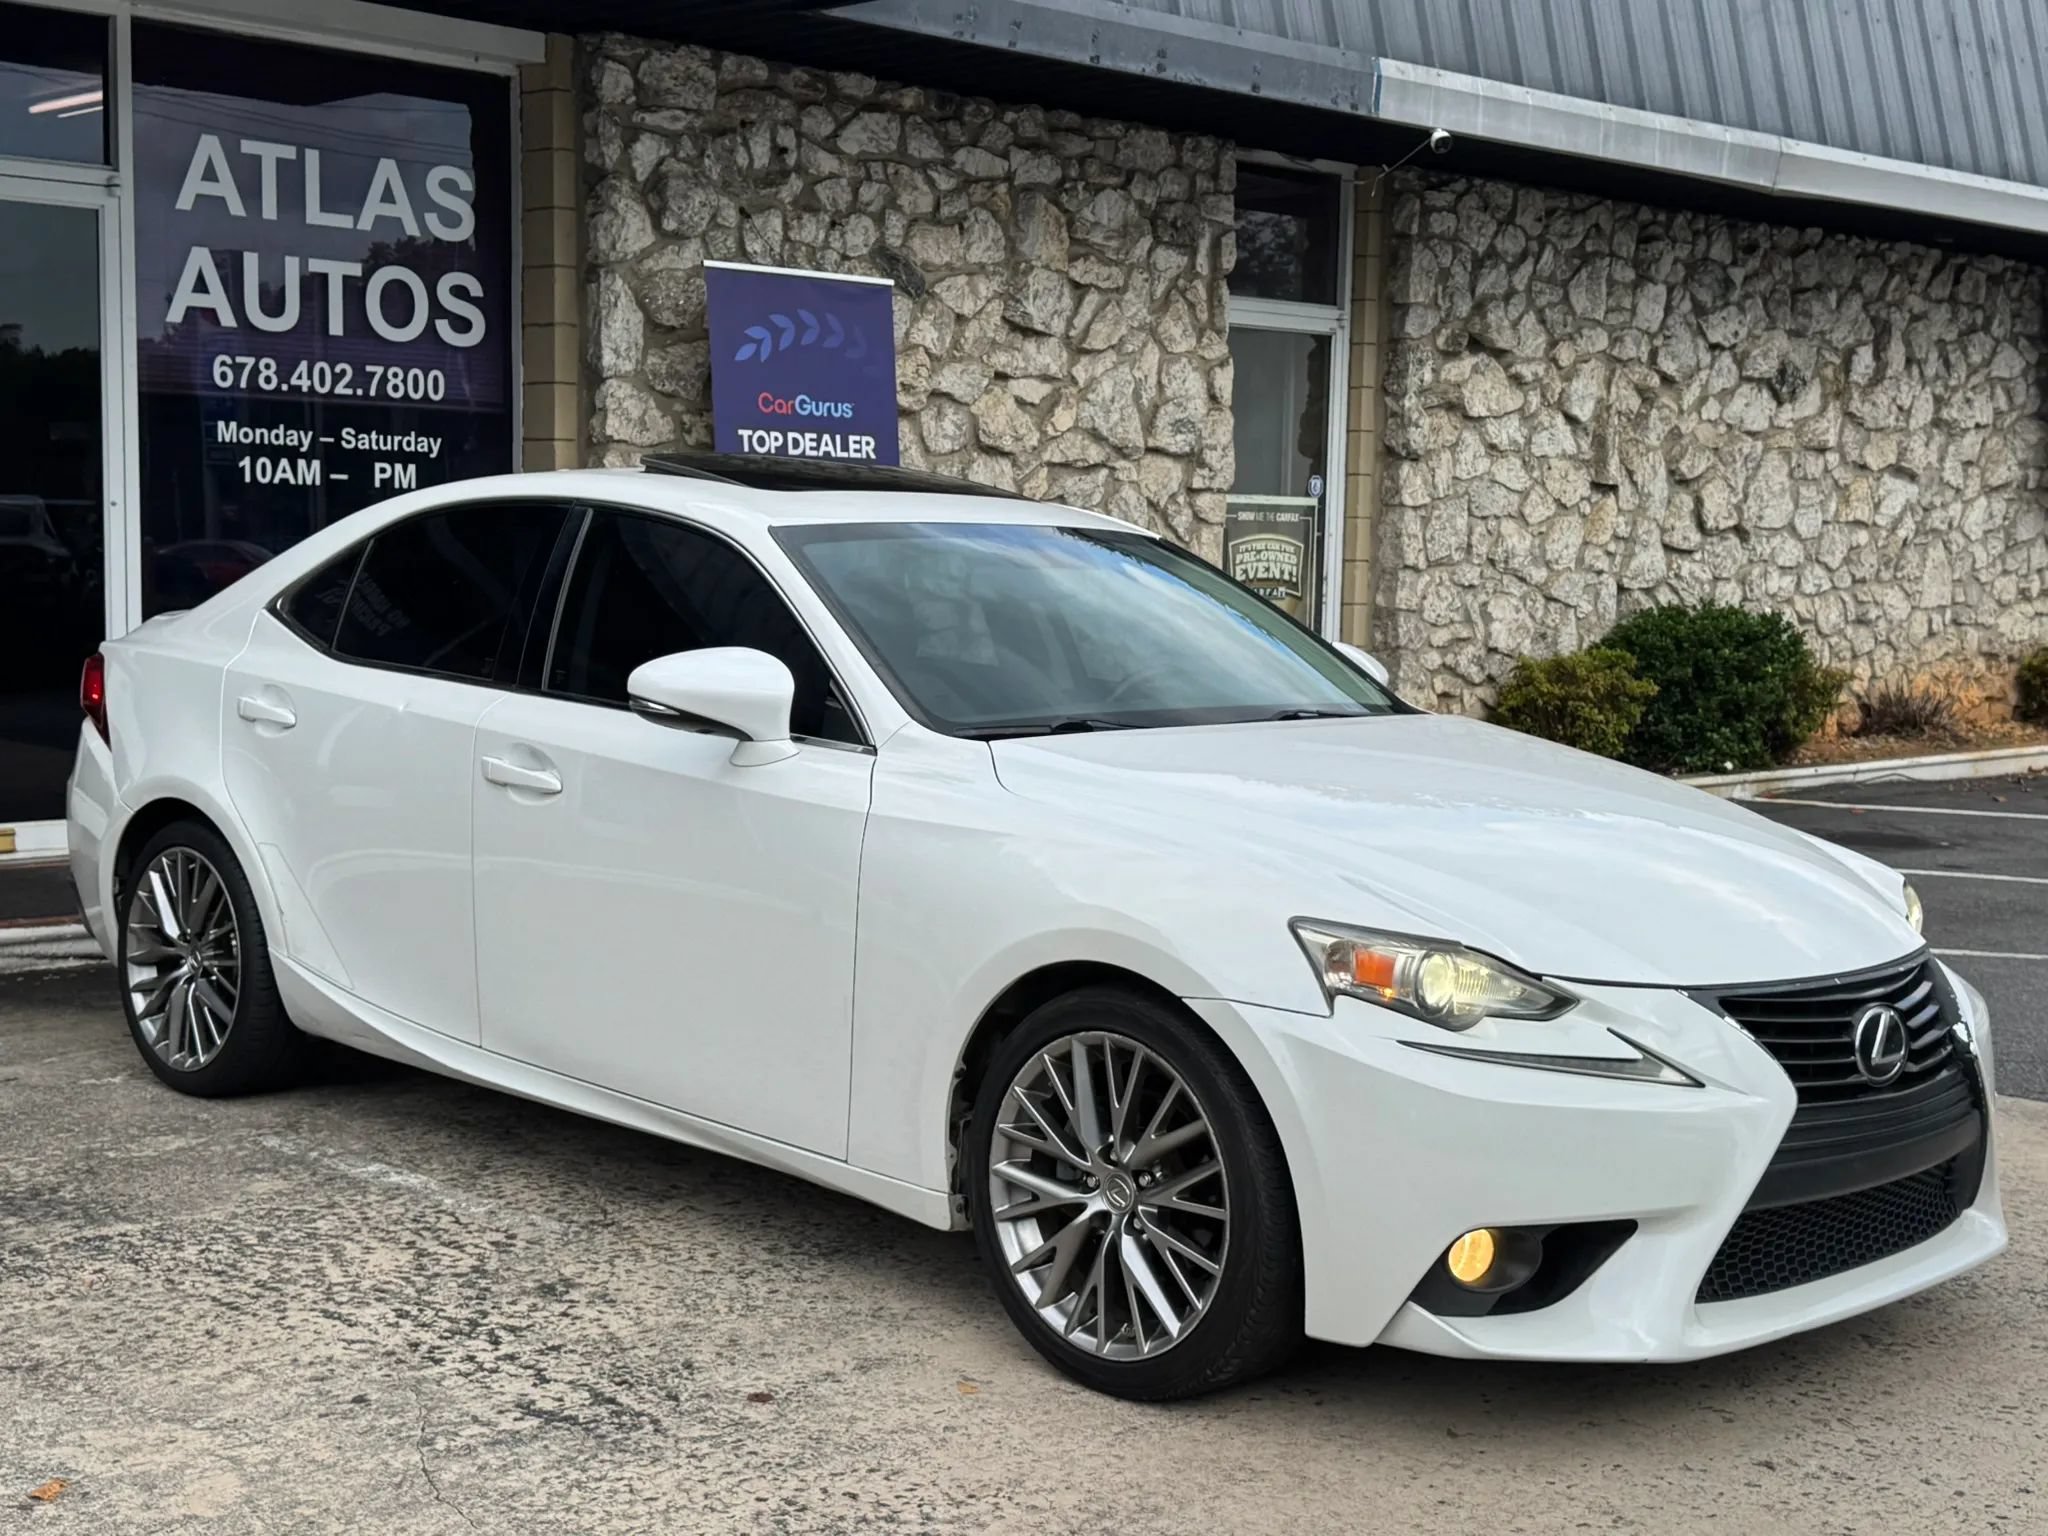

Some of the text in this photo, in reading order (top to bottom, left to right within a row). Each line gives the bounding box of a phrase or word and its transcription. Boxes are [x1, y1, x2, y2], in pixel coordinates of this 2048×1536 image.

[174, 133, 476, 243] ATLAS
[165, 246, 487, 348] AUTOS
[212, 354, 446, 402] 678.402.7800
[758, 391, 853, 418] CarGurus
[216, 420, 313, 452] Monday
[340, 427, 442, 458] Saturday
[737, 429, 877, 459] TOP DEALER
[238, 456, 321, 486] 10AM
[374, 463, 417, 490] PM
[1237, 511, 1255, 521] SHOW
[1235, 561, 1297, 582] EVENT!
